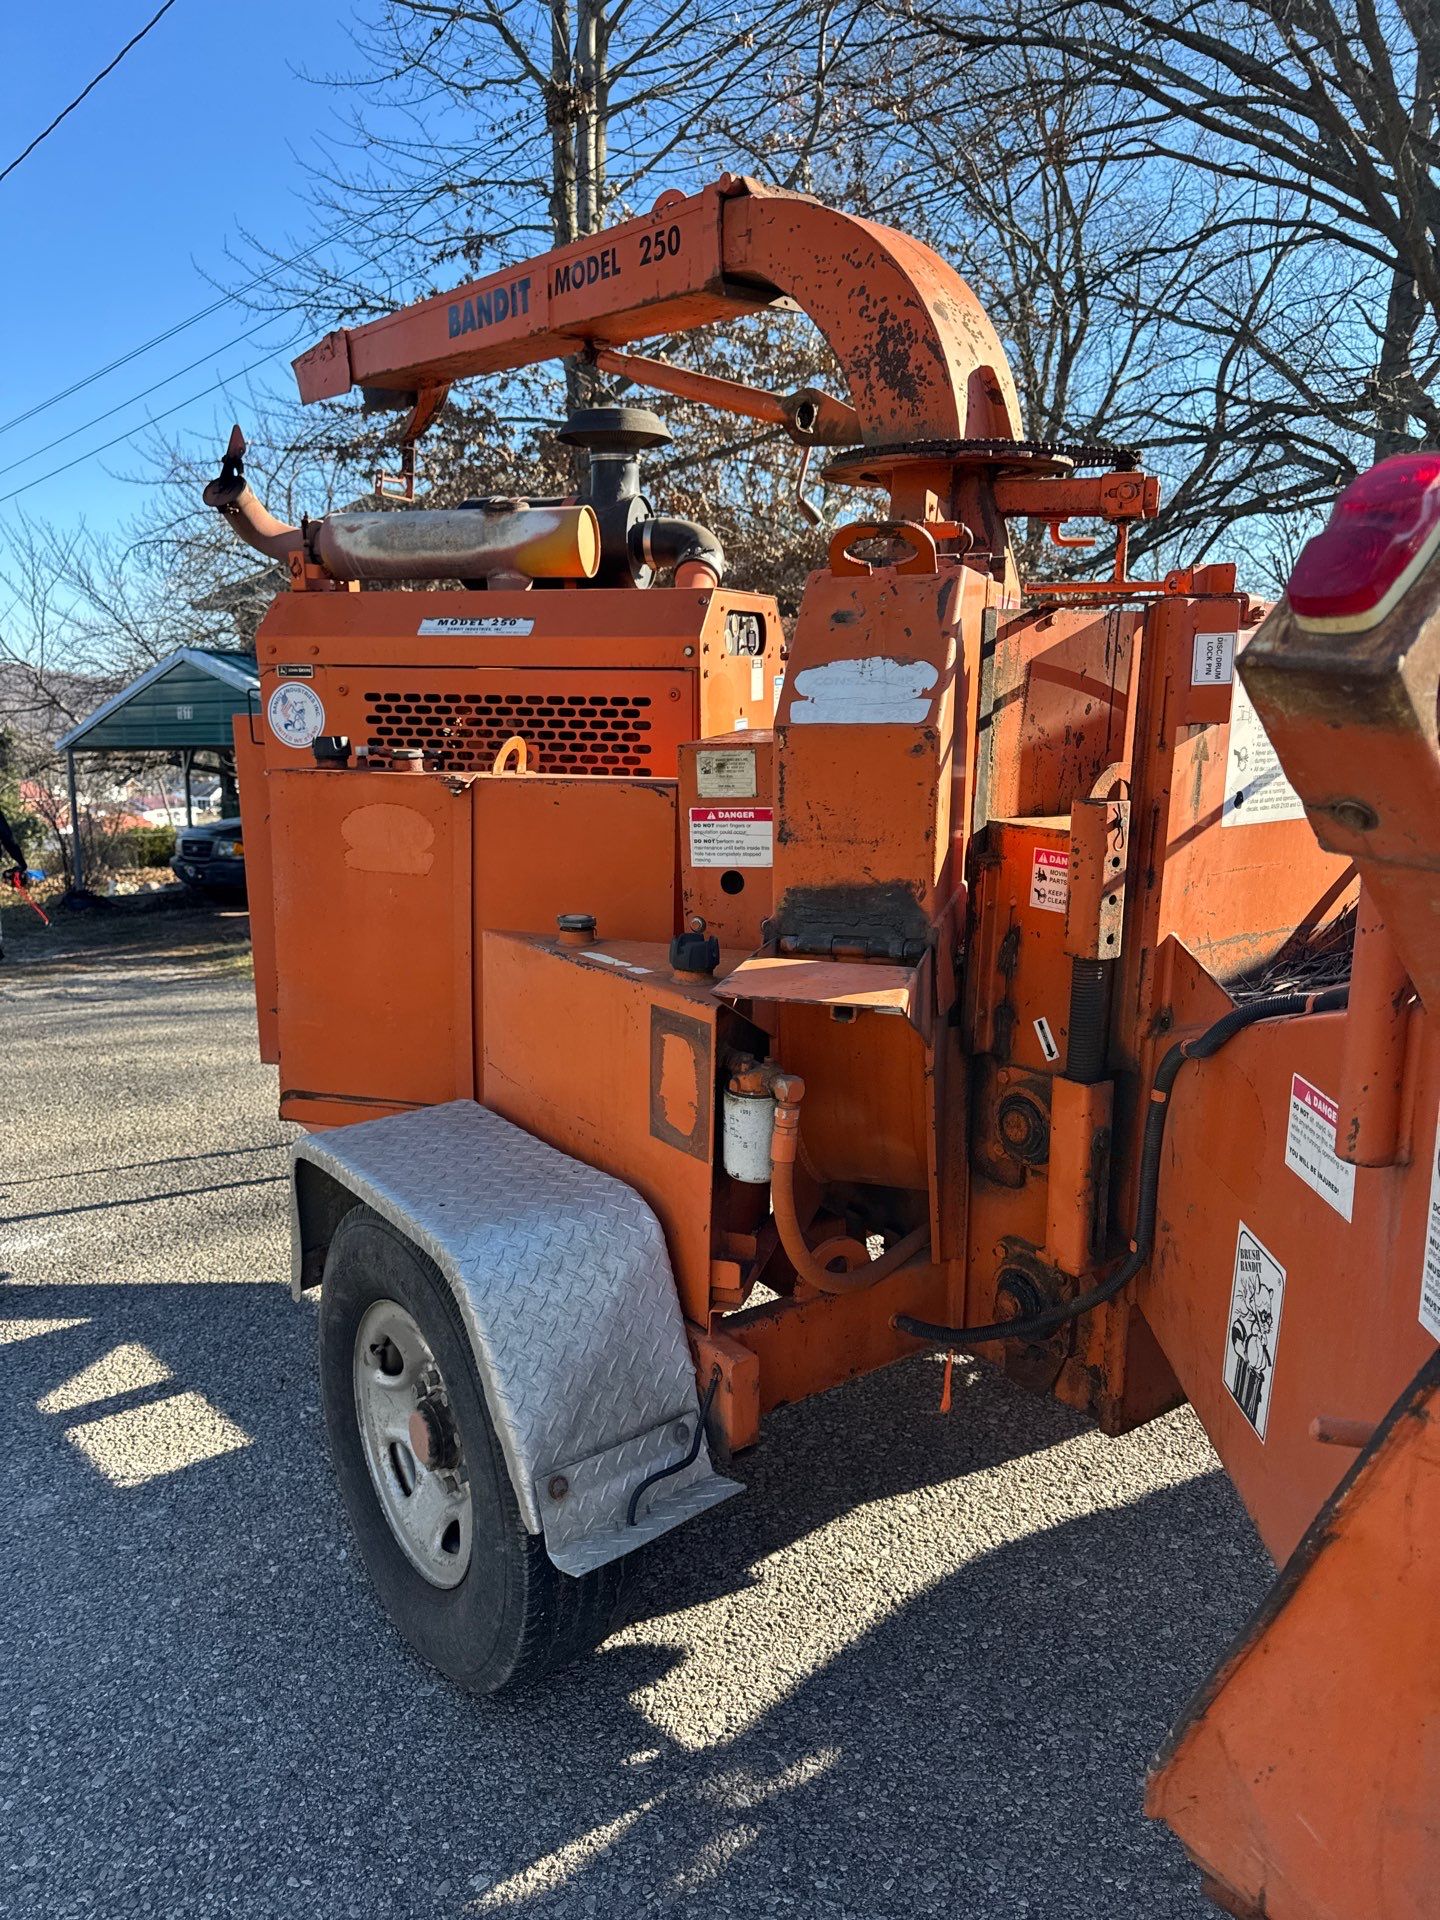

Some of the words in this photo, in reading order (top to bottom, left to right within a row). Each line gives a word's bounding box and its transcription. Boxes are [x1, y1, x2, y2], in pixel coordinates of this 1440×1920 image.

[448, 277, 531, 339] BANDIT
[554, 247, 621, 297] MODEL
[638, 225, 681, 267] 250
[437, 618, 484, 626] MODEL
[491, 618, 517, 626] 250
[1206, 641, 1214, 661] LOCK
[1214, 637, 1223, 680] DISC/DRUM
[1205, 663, 1213, 676] PIN
[718, 811, 755, 819] DANGER
[1049, 855, 1068, 866] DAN
[1049, 869, 1068, 878] MOVIN
[1049, 877, 1068, 886] PARTS
[1047, 889, 1063, 897] KEEP
[1047, 896, 1067, 906] CLEAR
[1293, 1101, 1299, 1111] DO
[1300, 1106, 1310, 1120] NOT
[1313, 1096, 1337, 1123] DANGE
[1322, 1146, 1340, 1171] operating
[1289, 1145, 1299, 1160] YOU
[1298, 1153, 1310, 1171] WILL
[1310, 1163, 1317, 1176] BE
[1317, 1169, 1340, 1197] INJURED!
[1240, 1248, 1261, 1261] BRUSH
[1240, 1260, 1262, 1274] BANDIT
